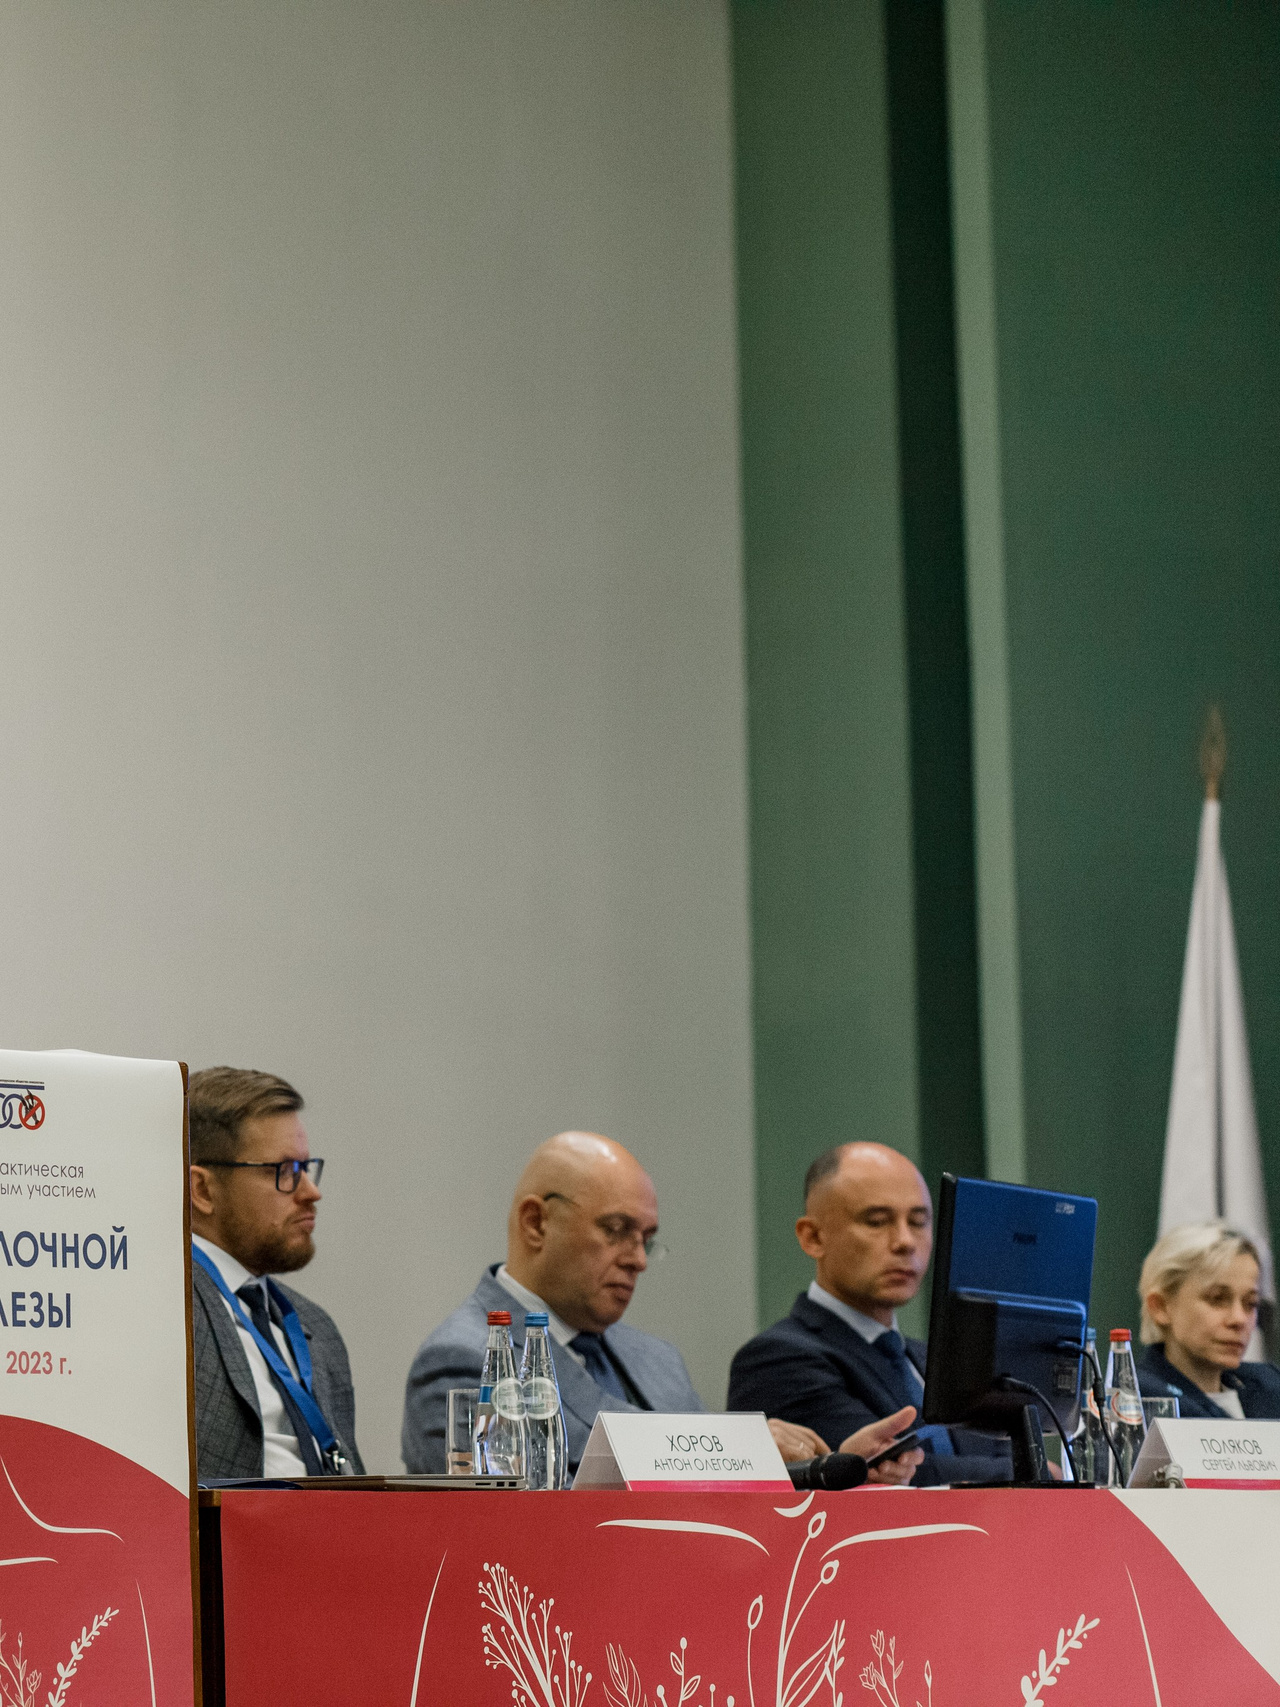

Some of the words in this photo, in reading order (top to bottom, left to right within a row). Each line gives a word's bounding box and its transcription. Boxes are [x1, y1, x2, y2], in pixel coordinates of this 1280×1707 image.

[27, 1184, 96, 1199] участием
[6, 1350, 53, 1375] 2023
[59, 1356, 72, 1375] г.
[665, 1434, 724, 1453] ХОРОВ
[1200, 1438, 1263, 1455] ПОЛЯКОВ
[654, 1458, 693, 1471] АНТОН
[693, 1458, 754, 1471] ОЛЕГОВИЧ
[1202, 1457, 1237, 1471] СЕРГЕЙ
[1237, 1460, 1279, 1472] ЛЬВОВИЧ
